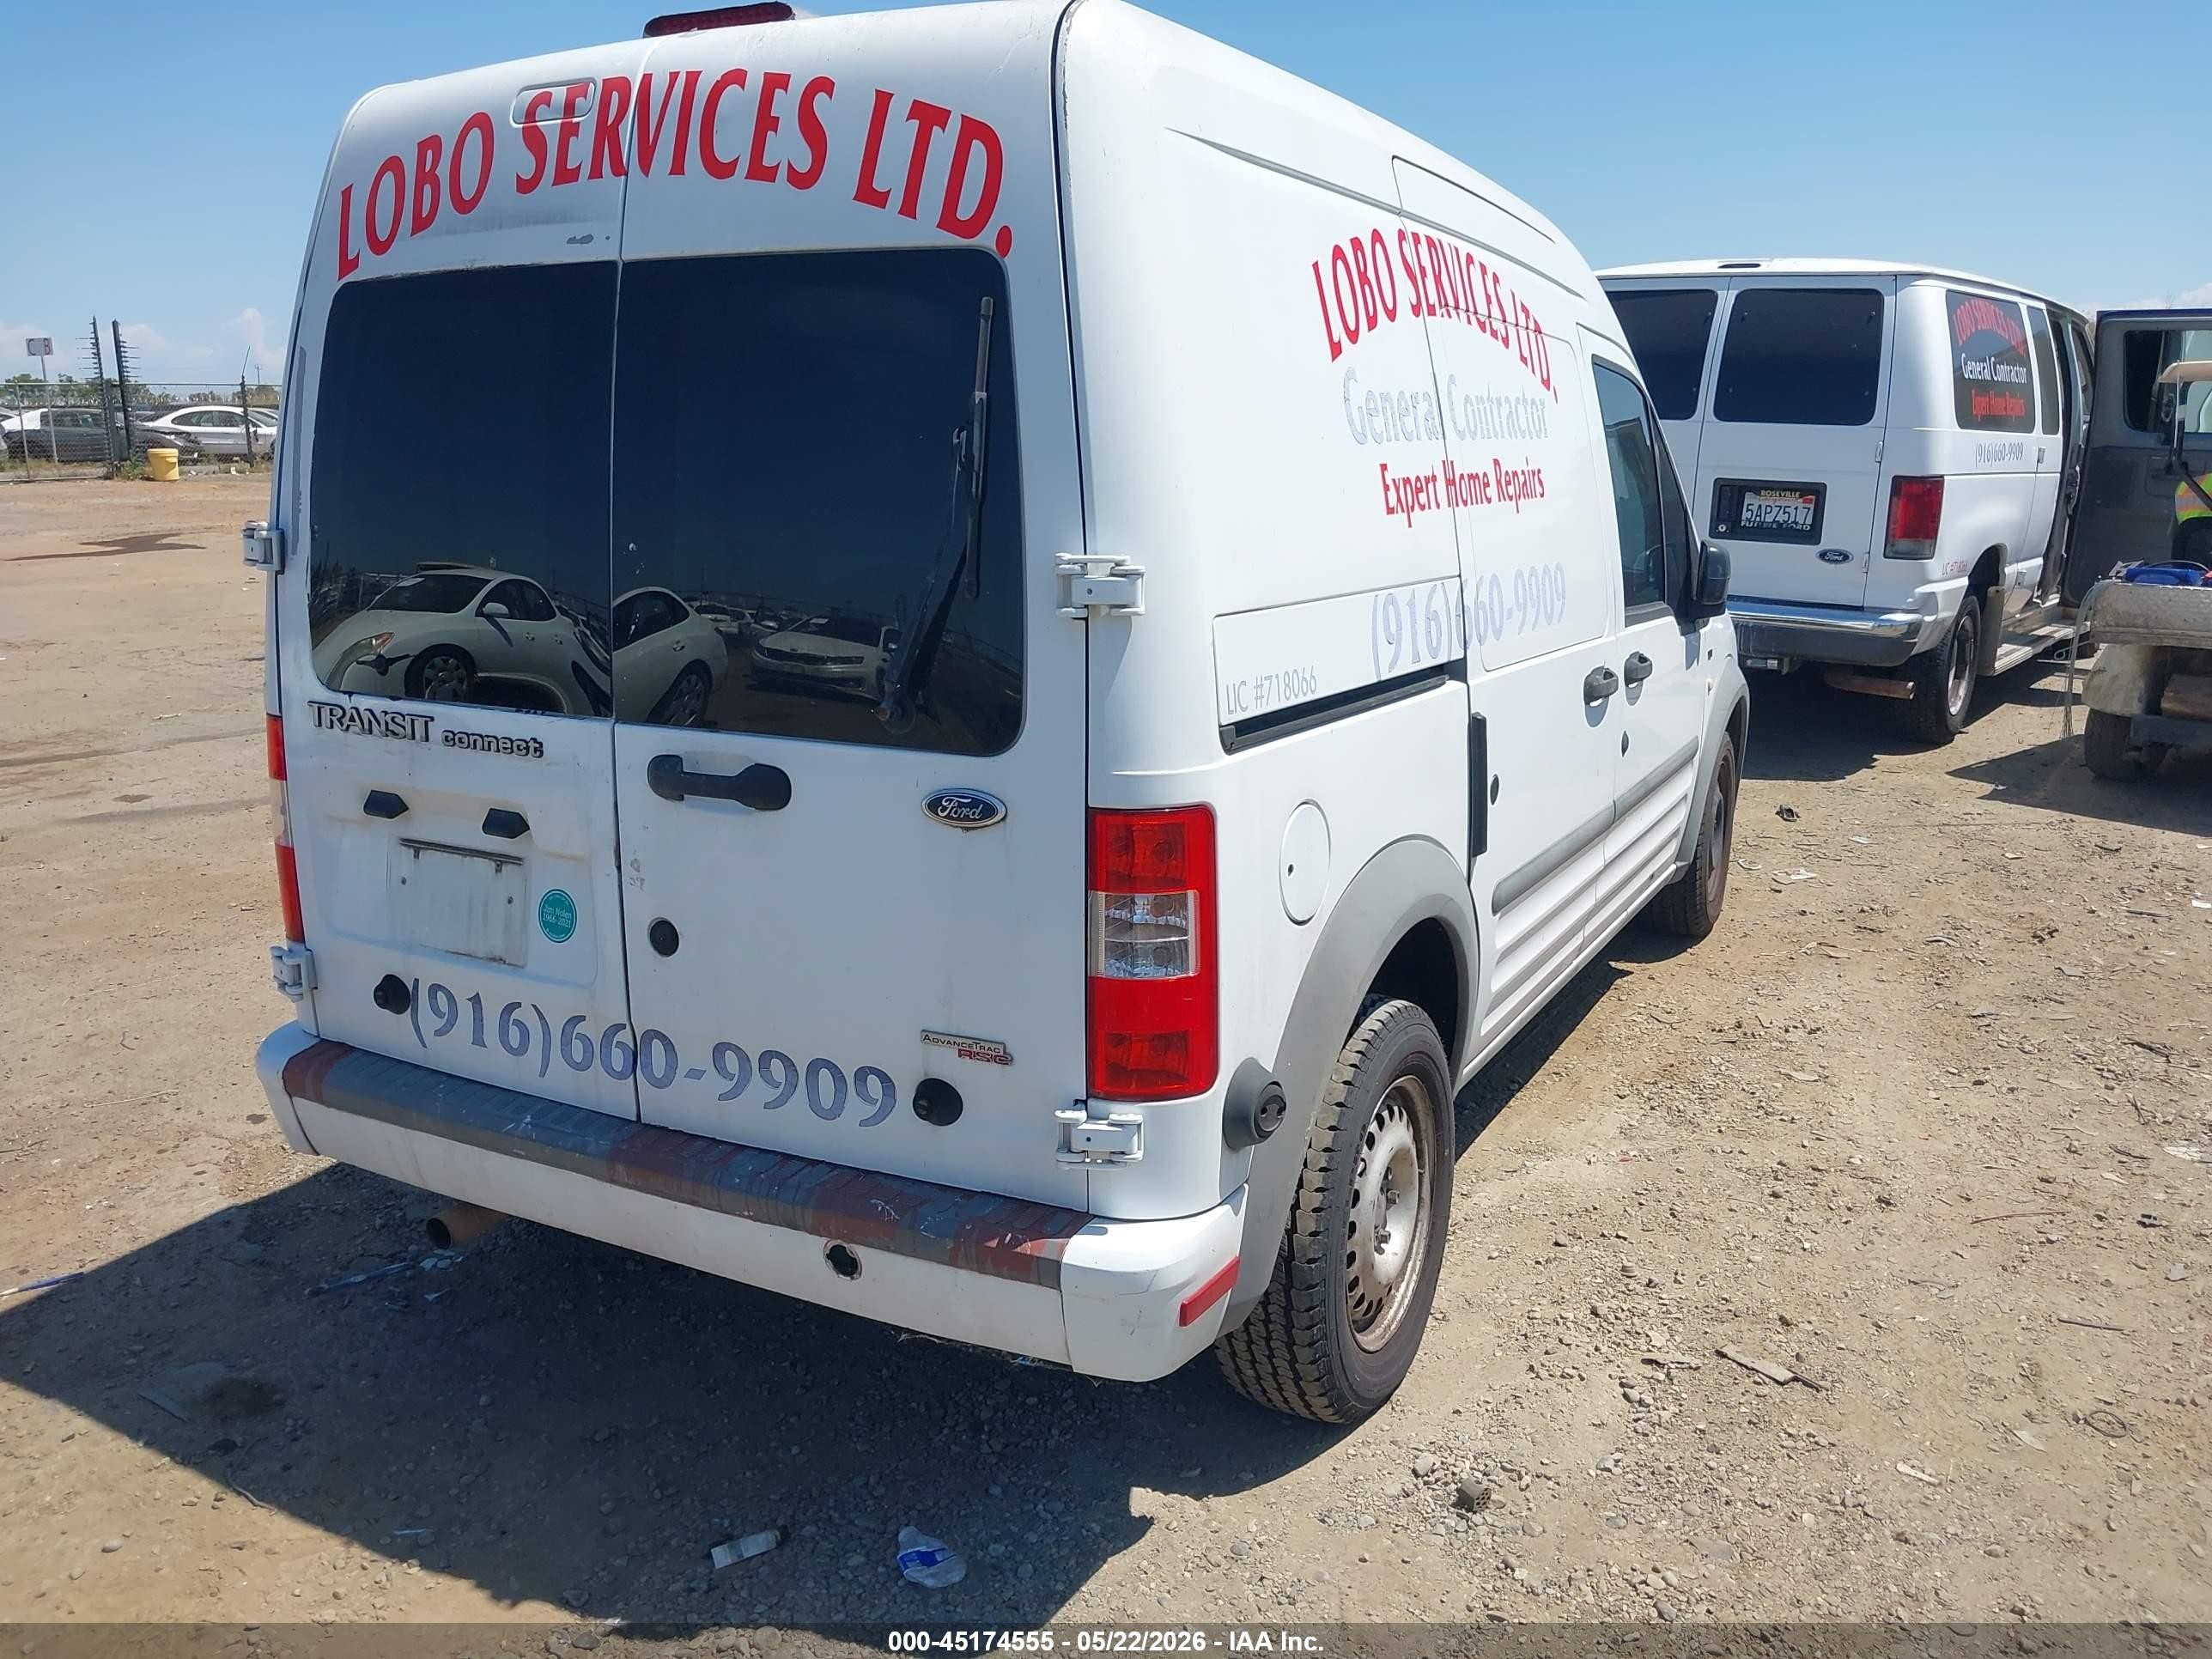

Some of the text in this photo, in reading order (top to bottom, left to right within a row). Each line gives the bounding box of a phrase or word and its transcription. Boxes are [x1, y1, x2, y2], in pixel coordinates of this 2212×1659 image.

[337, 68, 1013, 282] LOBO SERVICES LTD.
[1312, 228, 1558, 404] LOBO SERVICES LTD.
[1961, 353, 2027, 384] General Contractor
[1447, 374, 1549, 441] Contractor
[1975, 441, 2024, 468] (916)660-9909
[1379, 456, 1545, 528] Expert Home Repairs
[1745, 503, 1811, 525] 5APZ517
[1760, 489, 1801, 498] ROSEVILLE
[1824, 551, 1844, 561] Ford
[1371, 562, 1566, 682] (916)660-9909
[1225, 665, 1318, 715] LIC #718066
[307, 701, 544, 758] TRANSIT connect
[937, 796, 983, 819] Ford
[410, 977, 897, 1127] (916)660-9909
[957, 1048, 1013, 1066] RSC
